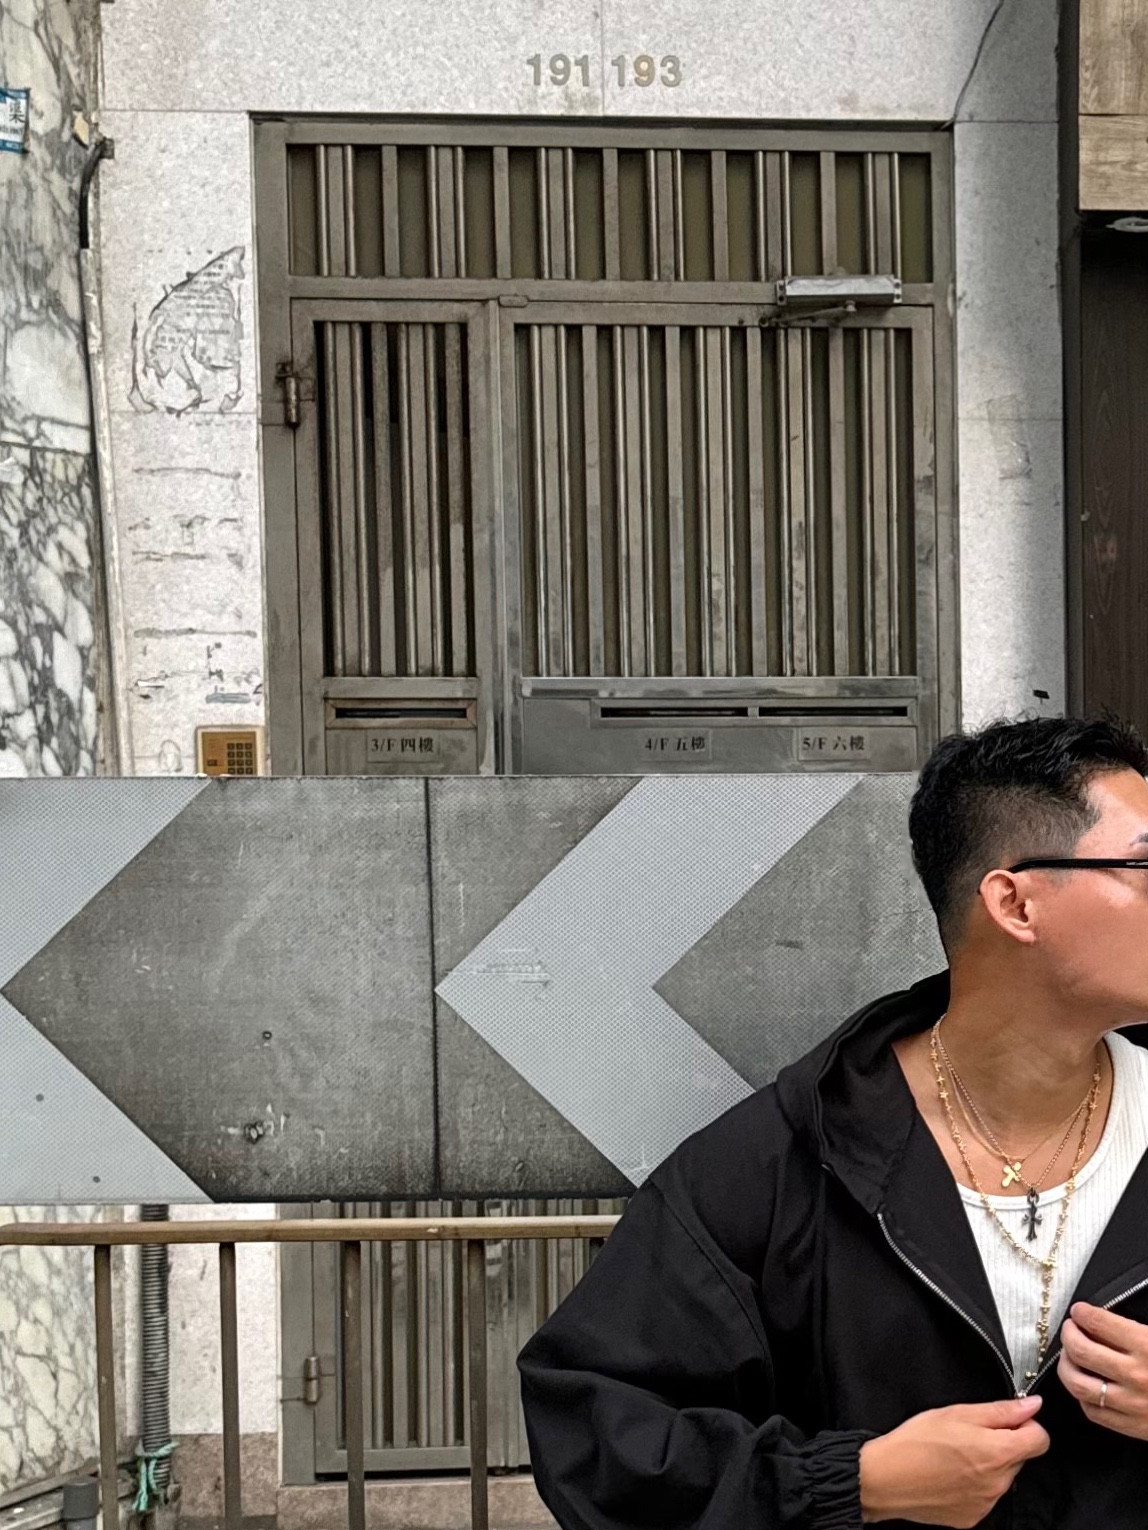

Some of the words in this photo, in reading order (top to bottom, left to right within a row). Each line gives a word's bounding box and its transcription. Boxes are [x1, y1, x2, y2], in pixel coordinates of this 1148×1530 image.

[526, 53, 590, 87] 191
[611, 54, 683, 88] 193
[371, 738, 397, 752] 3/F
[645, 737, 670, 751] 4/F
[802, 736, 828, 751] 5/F
